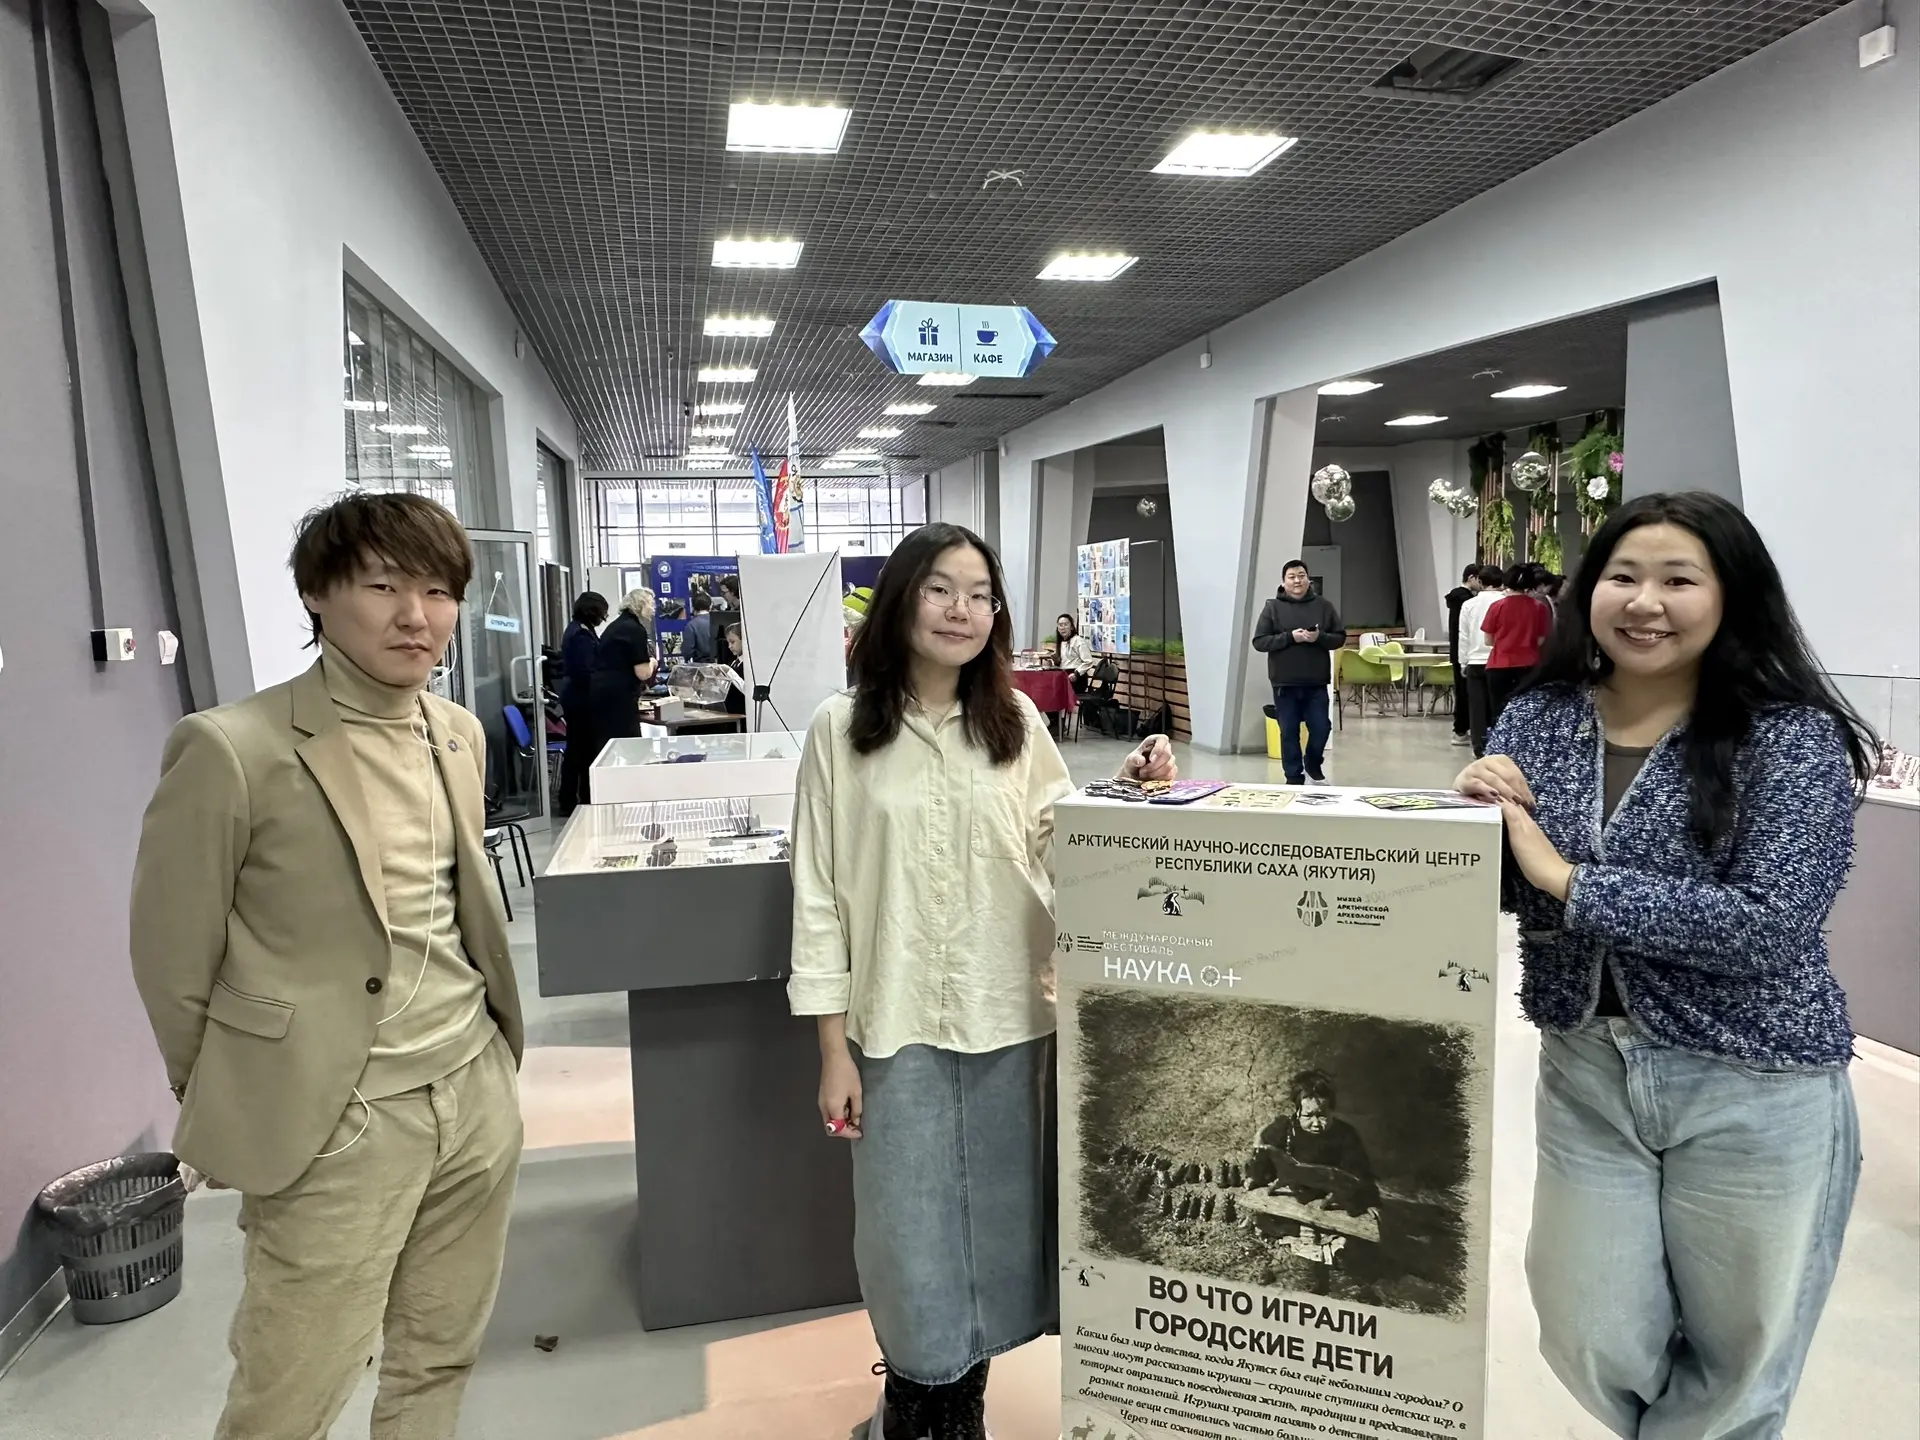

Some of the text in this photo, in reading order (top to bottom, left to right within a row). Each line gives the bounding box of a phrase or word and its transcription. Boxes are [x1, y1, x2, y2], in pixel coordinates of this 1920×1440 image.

[907, 352, 953, 363] МАГАЗИН
[973, 353, 1003, 364] КАФЕ
[1067, 833, 1481, 867] АРКТИЧЕСКИЙ НАУЧНО-ИССЛЕДОВАТЕЛЬСКИЙ ЦЕНТР
[1155, 857, 1252, 875] РЕСПУБЛИКИ
[1257, 862, 1299, 877] САХА
[1303, 865, 1376, 884] (ЯКУТИЯ)
[1103, 931, 1213, 947] МЕЖДУНАРОДНЫЙ
[1103, 943, 1174, 956] ФЕСТИВАЛЬ
[1104, 956, 1193, 986] НАУКА
[1149, 1275, 1377, 1340] ВО ЧТО ИГРАЛИ
[1135, 1307, 1393, 1379] ГОРОДСКИЕ ДЕТИ
[1076, 1325, 1108, 1341] Каким
[1110, 1334, 1129, 1346] был
[1131, 1340, 1152, 1351] мир
[1205, 1353, 1234, 1367] когда
[1236, 1358, 1277, 1376] Якутск
[1280, 1367, 1302, 1380] был
[1303, 1373, 1326, 1386] ещё
[1328, 1379, 1391, 1398] небольшим
[1393, 1391, 1450, 1410] городом?
[1452, 1401, 1464, 1412] О
[1073, 1342, 1110, 1357] многом
[1112, 1350, 1144, 1364] могут
[1145, 1357, 1205, 1376] рассказать
[1207, 1369, 1252, 1386] игрушки
[1268, 1383, 1322, 1400] скромные
[1324, 1394, 1379, 1412] спутники
[1381, 1404, 1430, 1423] детских
[1459, 1422, 1466, 1430] в
[1080, 1358, 1124, 1374] которых
[1126, 1368, 1185, 1387] отразились
[1187, 1380, 1257, 1402] повседневная
[1300, 1405, 1357, 1422] традиции
[1358, 1417, 1366, 1425] и
[1089, 1375, 1125, 1390] разных
[1183, 1393, 1230, 1412] Игрушки
[1231, 1405, 1271, 1421] хранят
[1274, 1414, 1317, 1430] память
[1079, 1387, 1134, 1406] обыденные
[1136, 1400, 1162, 1413] вещи
[1163, 1406, 1230, 1427] становились
[1232, 1421, 1274, 1436] частью
[1120, 1408, 1222, 1440] Через них оживают
